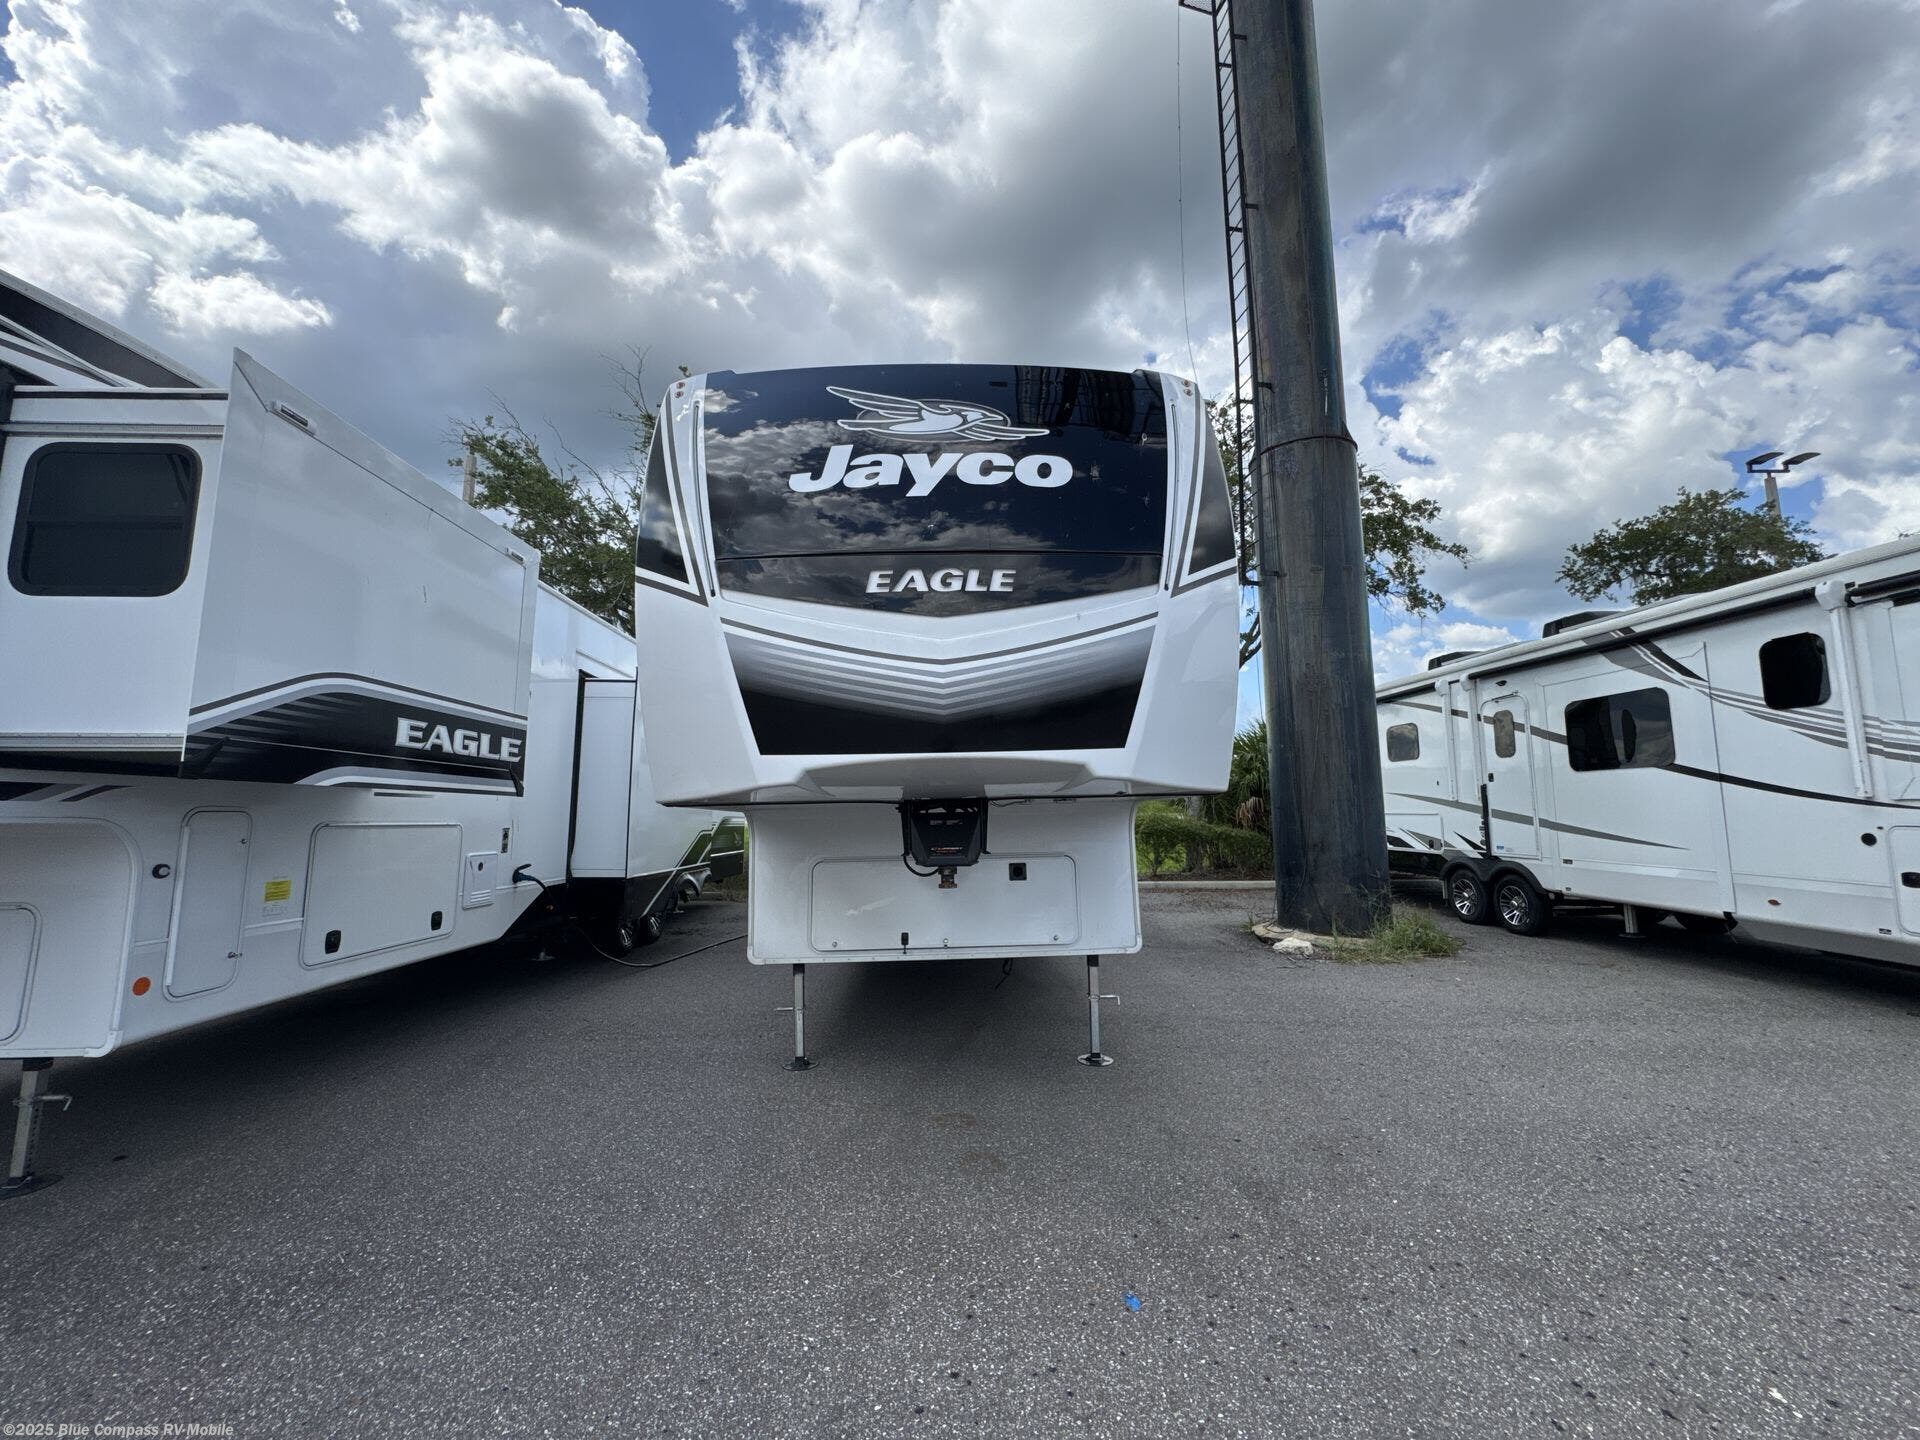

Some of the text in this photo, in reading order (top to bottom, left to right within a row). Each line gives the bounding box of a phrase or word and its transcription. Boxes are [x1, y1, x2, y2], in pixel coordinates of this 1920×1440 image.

[788, 444, 1074, 497] Jayco
[865, 568, 1017, 594] EAGLE
[395, 717, 522, 762] EAGLE
